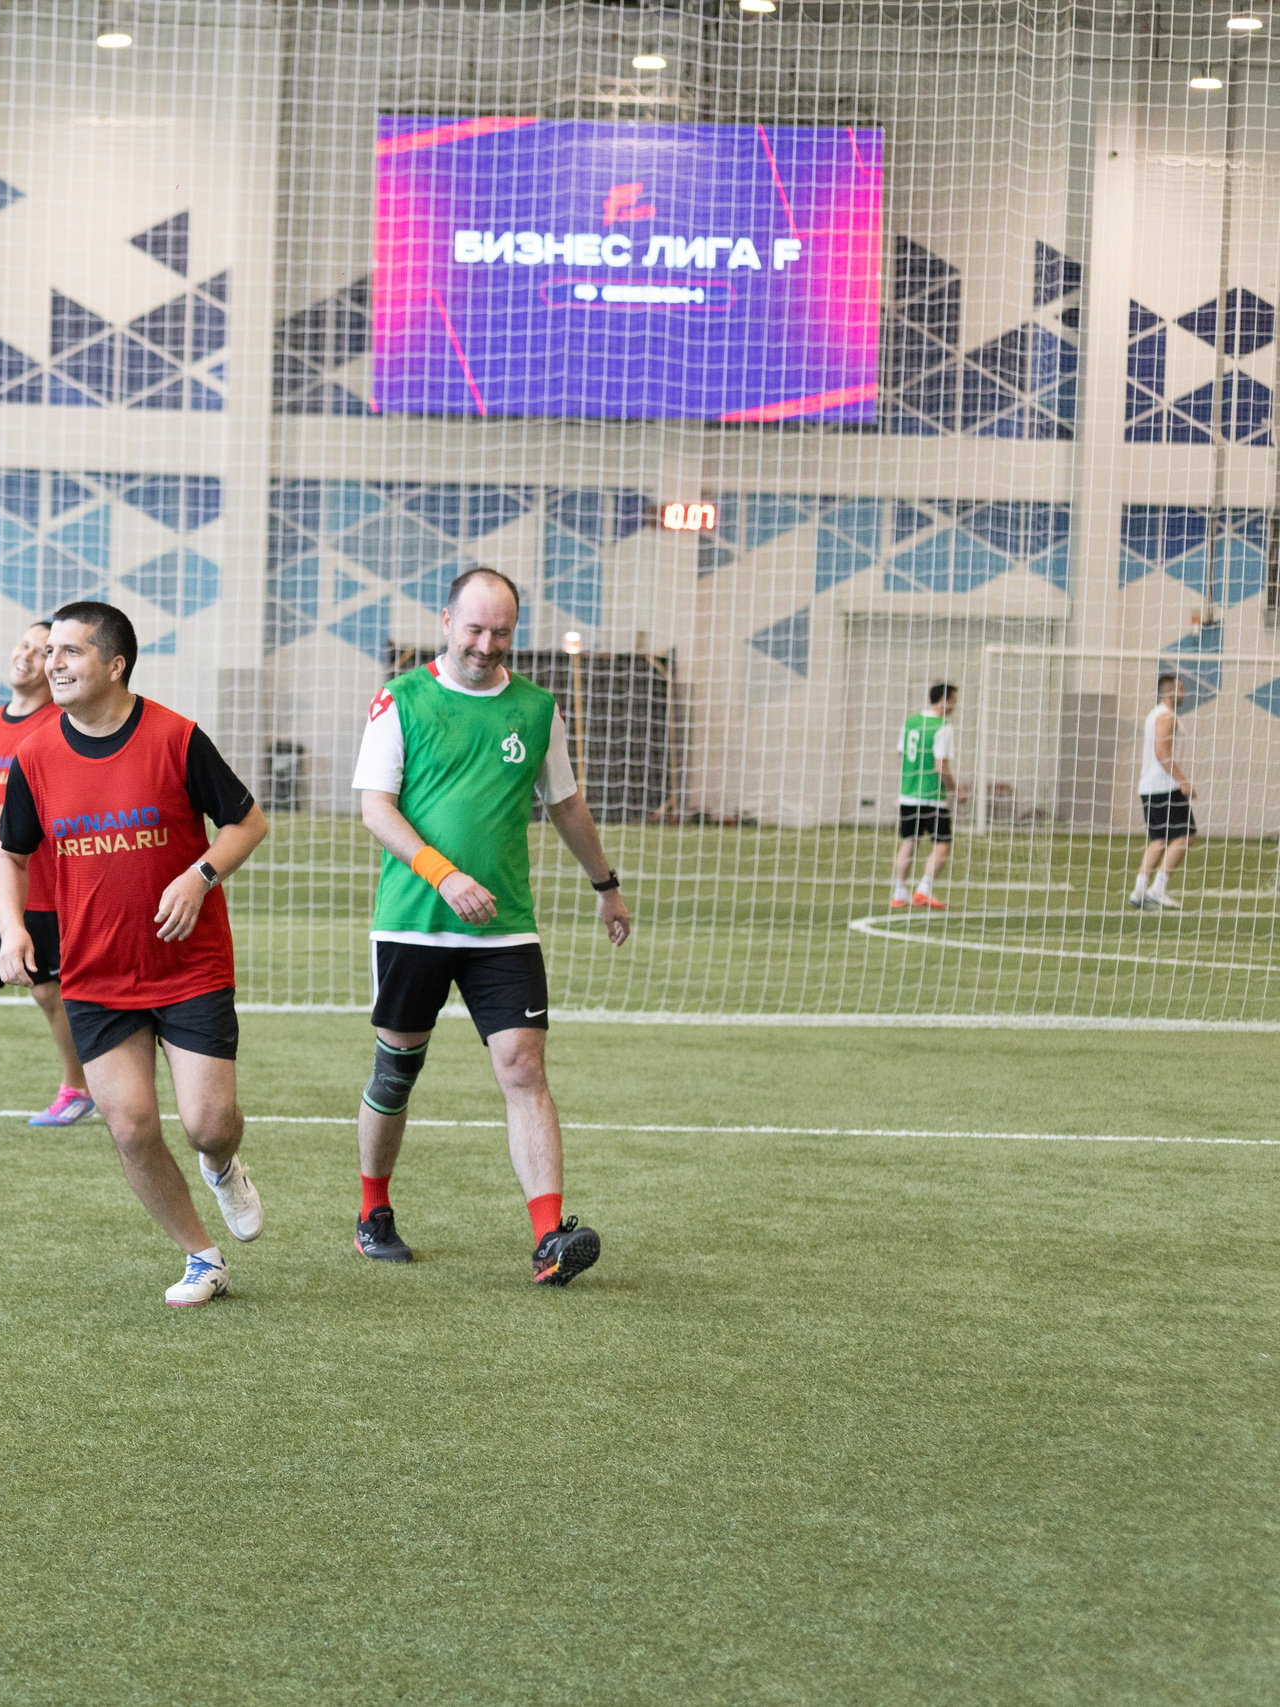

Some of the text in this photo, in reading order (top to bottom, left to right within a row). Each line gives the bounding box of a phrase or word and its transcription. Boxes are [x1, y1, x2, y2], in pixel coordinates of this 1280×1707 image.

[454, 229, 802, 270] БИЗНЕС ЛИГА F
[53, 806, 159, 837] DYNAMO
[56, 827, 169, 858] ARENA.RU
